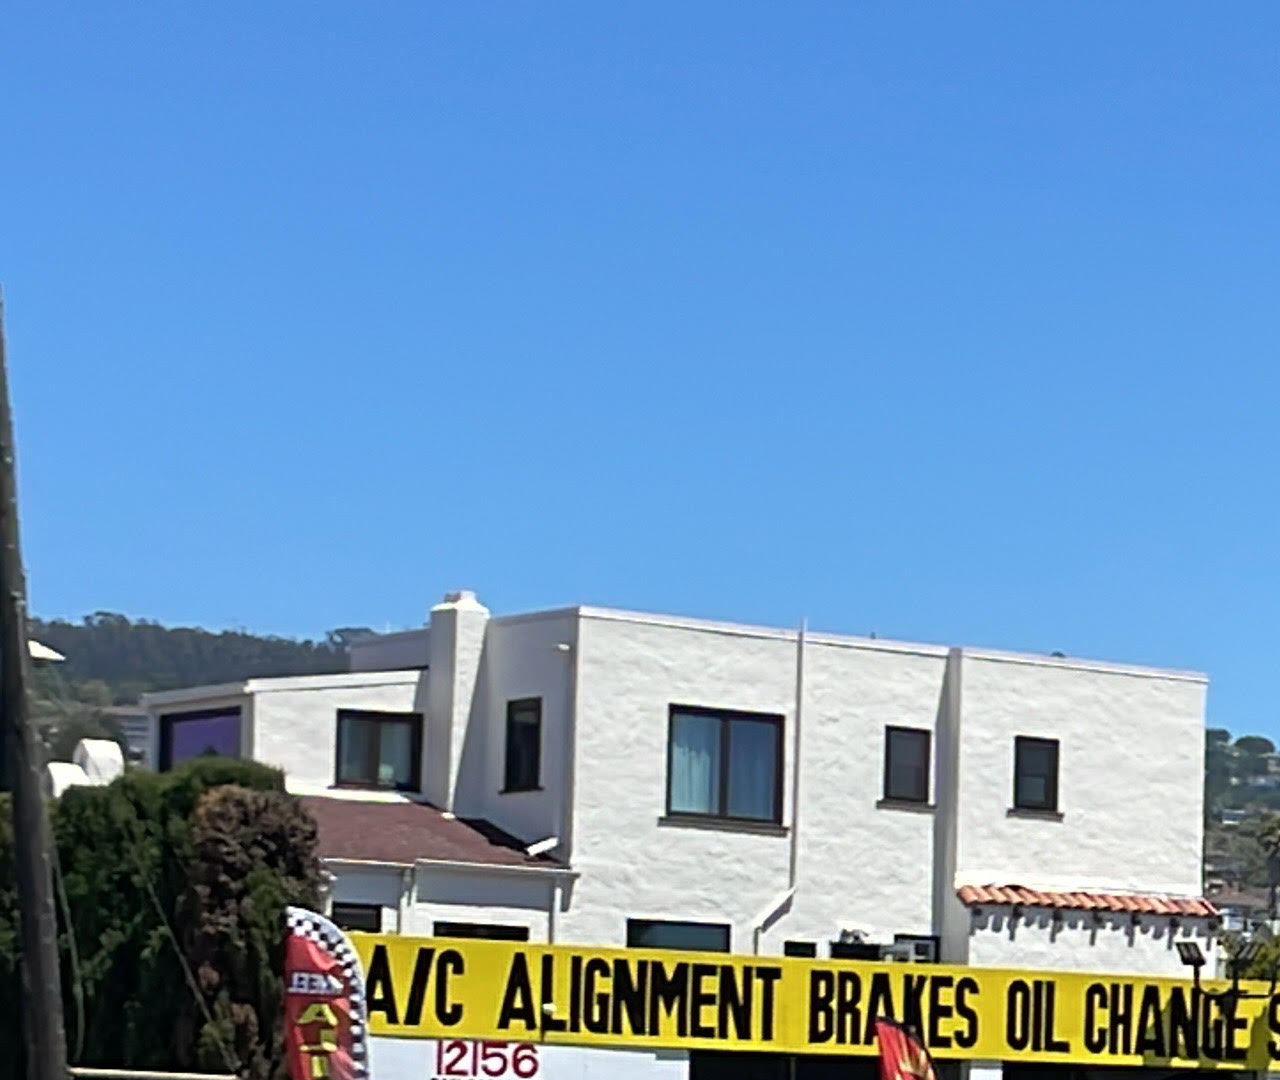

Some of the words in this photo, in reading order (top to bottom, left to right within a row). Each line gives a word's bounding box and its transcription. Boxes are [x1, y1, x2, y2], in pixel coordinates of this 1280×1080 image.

[364, 945, 465, 1026] A/C
[497, 951, 782, 1042] ALIGNMENT
[808, 969, 980, 1050] BRAKES
[1006, 979, 1070, 1053] OIL
[1084, 983, 1248, 1061] CHANGE
[436, 1040, 539, 1078] 12156
